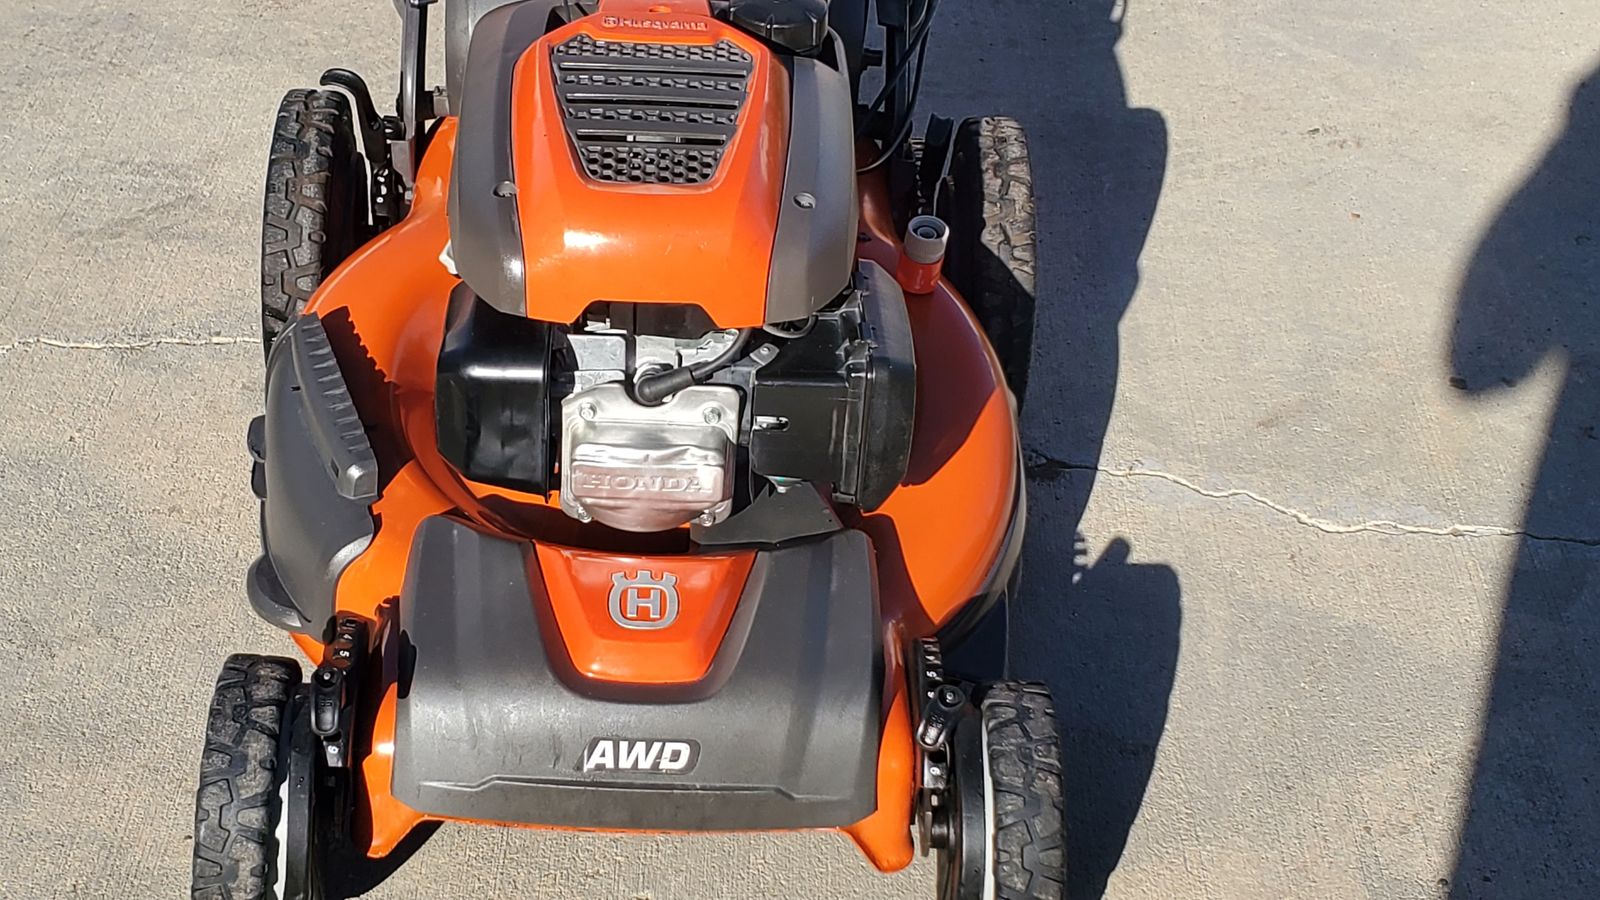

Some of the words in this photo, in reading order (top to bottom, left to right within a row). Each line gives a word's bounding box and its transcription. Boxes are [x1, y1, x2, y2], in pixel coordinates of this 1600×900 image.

[582, 473, 713, 493] HONDA
[339, 650, 350, 658] 5
[585, 740, 691, 770] AWD
